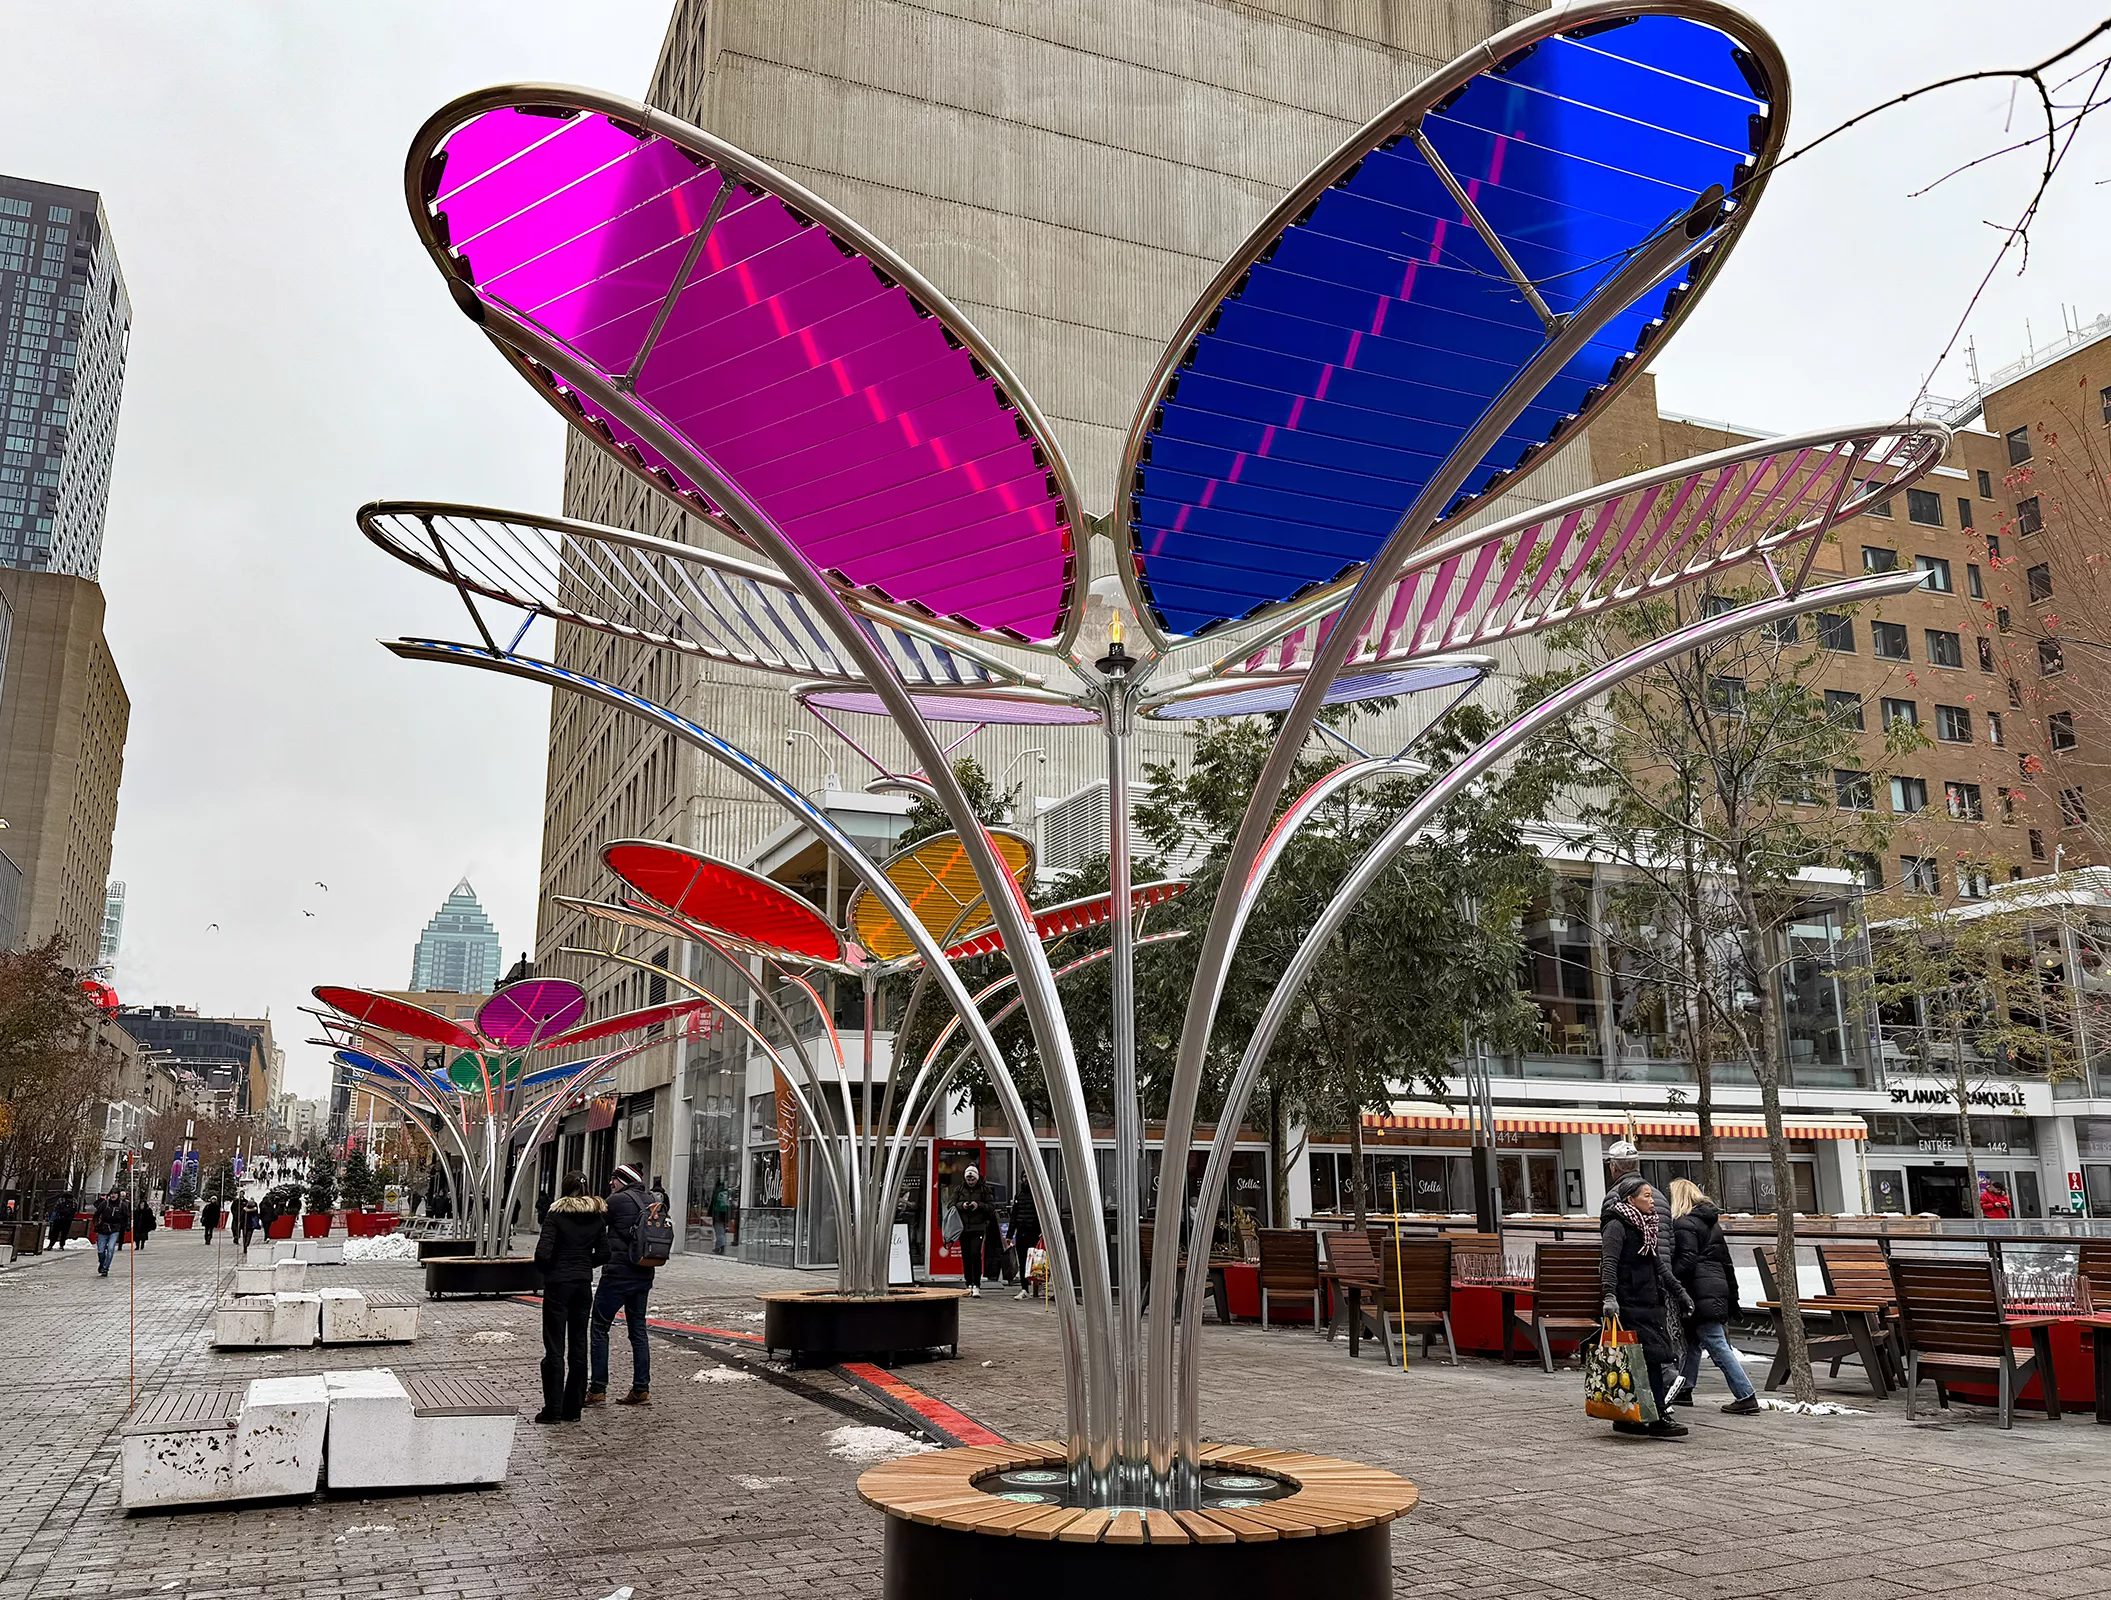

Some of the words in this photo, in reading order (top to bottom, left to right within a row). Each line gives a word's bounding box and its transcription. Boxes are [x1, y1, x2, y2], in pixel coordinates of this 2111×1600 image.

[1888, 1089, 1952, 1104] SPLANADE
[1918, 1138, 1953, 1152] ENTRÉE
[1987, 1142, 2008, 1153] 1442
[1236, 1177, 1261, 1191] Stella
[1417, 1180, 1442, 1194] Stella
